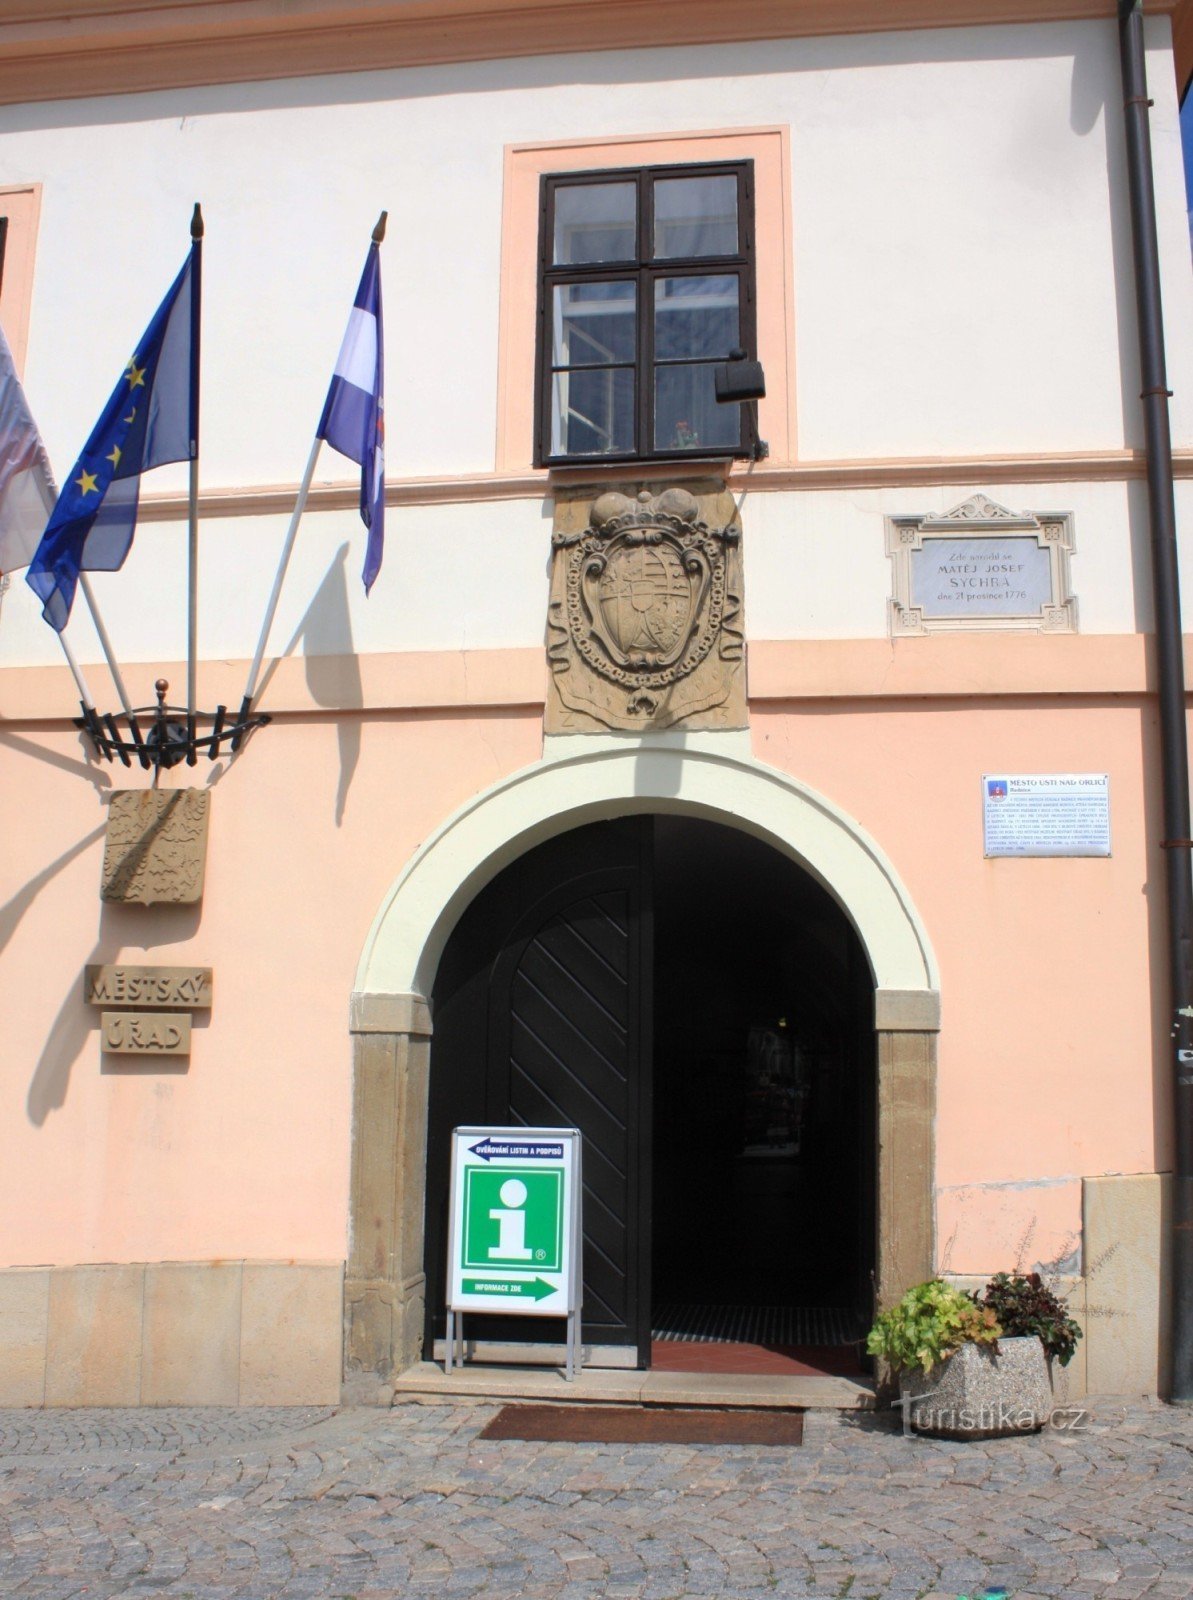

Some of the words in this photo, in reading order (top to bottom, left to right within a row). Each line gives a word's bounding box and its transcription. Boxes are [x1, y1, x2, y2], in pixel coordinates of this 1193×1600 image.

[949, 553, 966, 561] Zde
[985, 564, 1025, 573] JOSEF
[950, 577, 1010, 588] SYCHRA
[966, 592, 1003, 602] prosince
[1005, 590, 1026, 599] 1776
[89, 971, 206, 1002] MĚSTSKÝ
[107, 1019, 182, 1049] ÚŘAD
[474, 1283, 509, 1292] INFORMACE
[510, 1284, 521, 1292] ZDE
